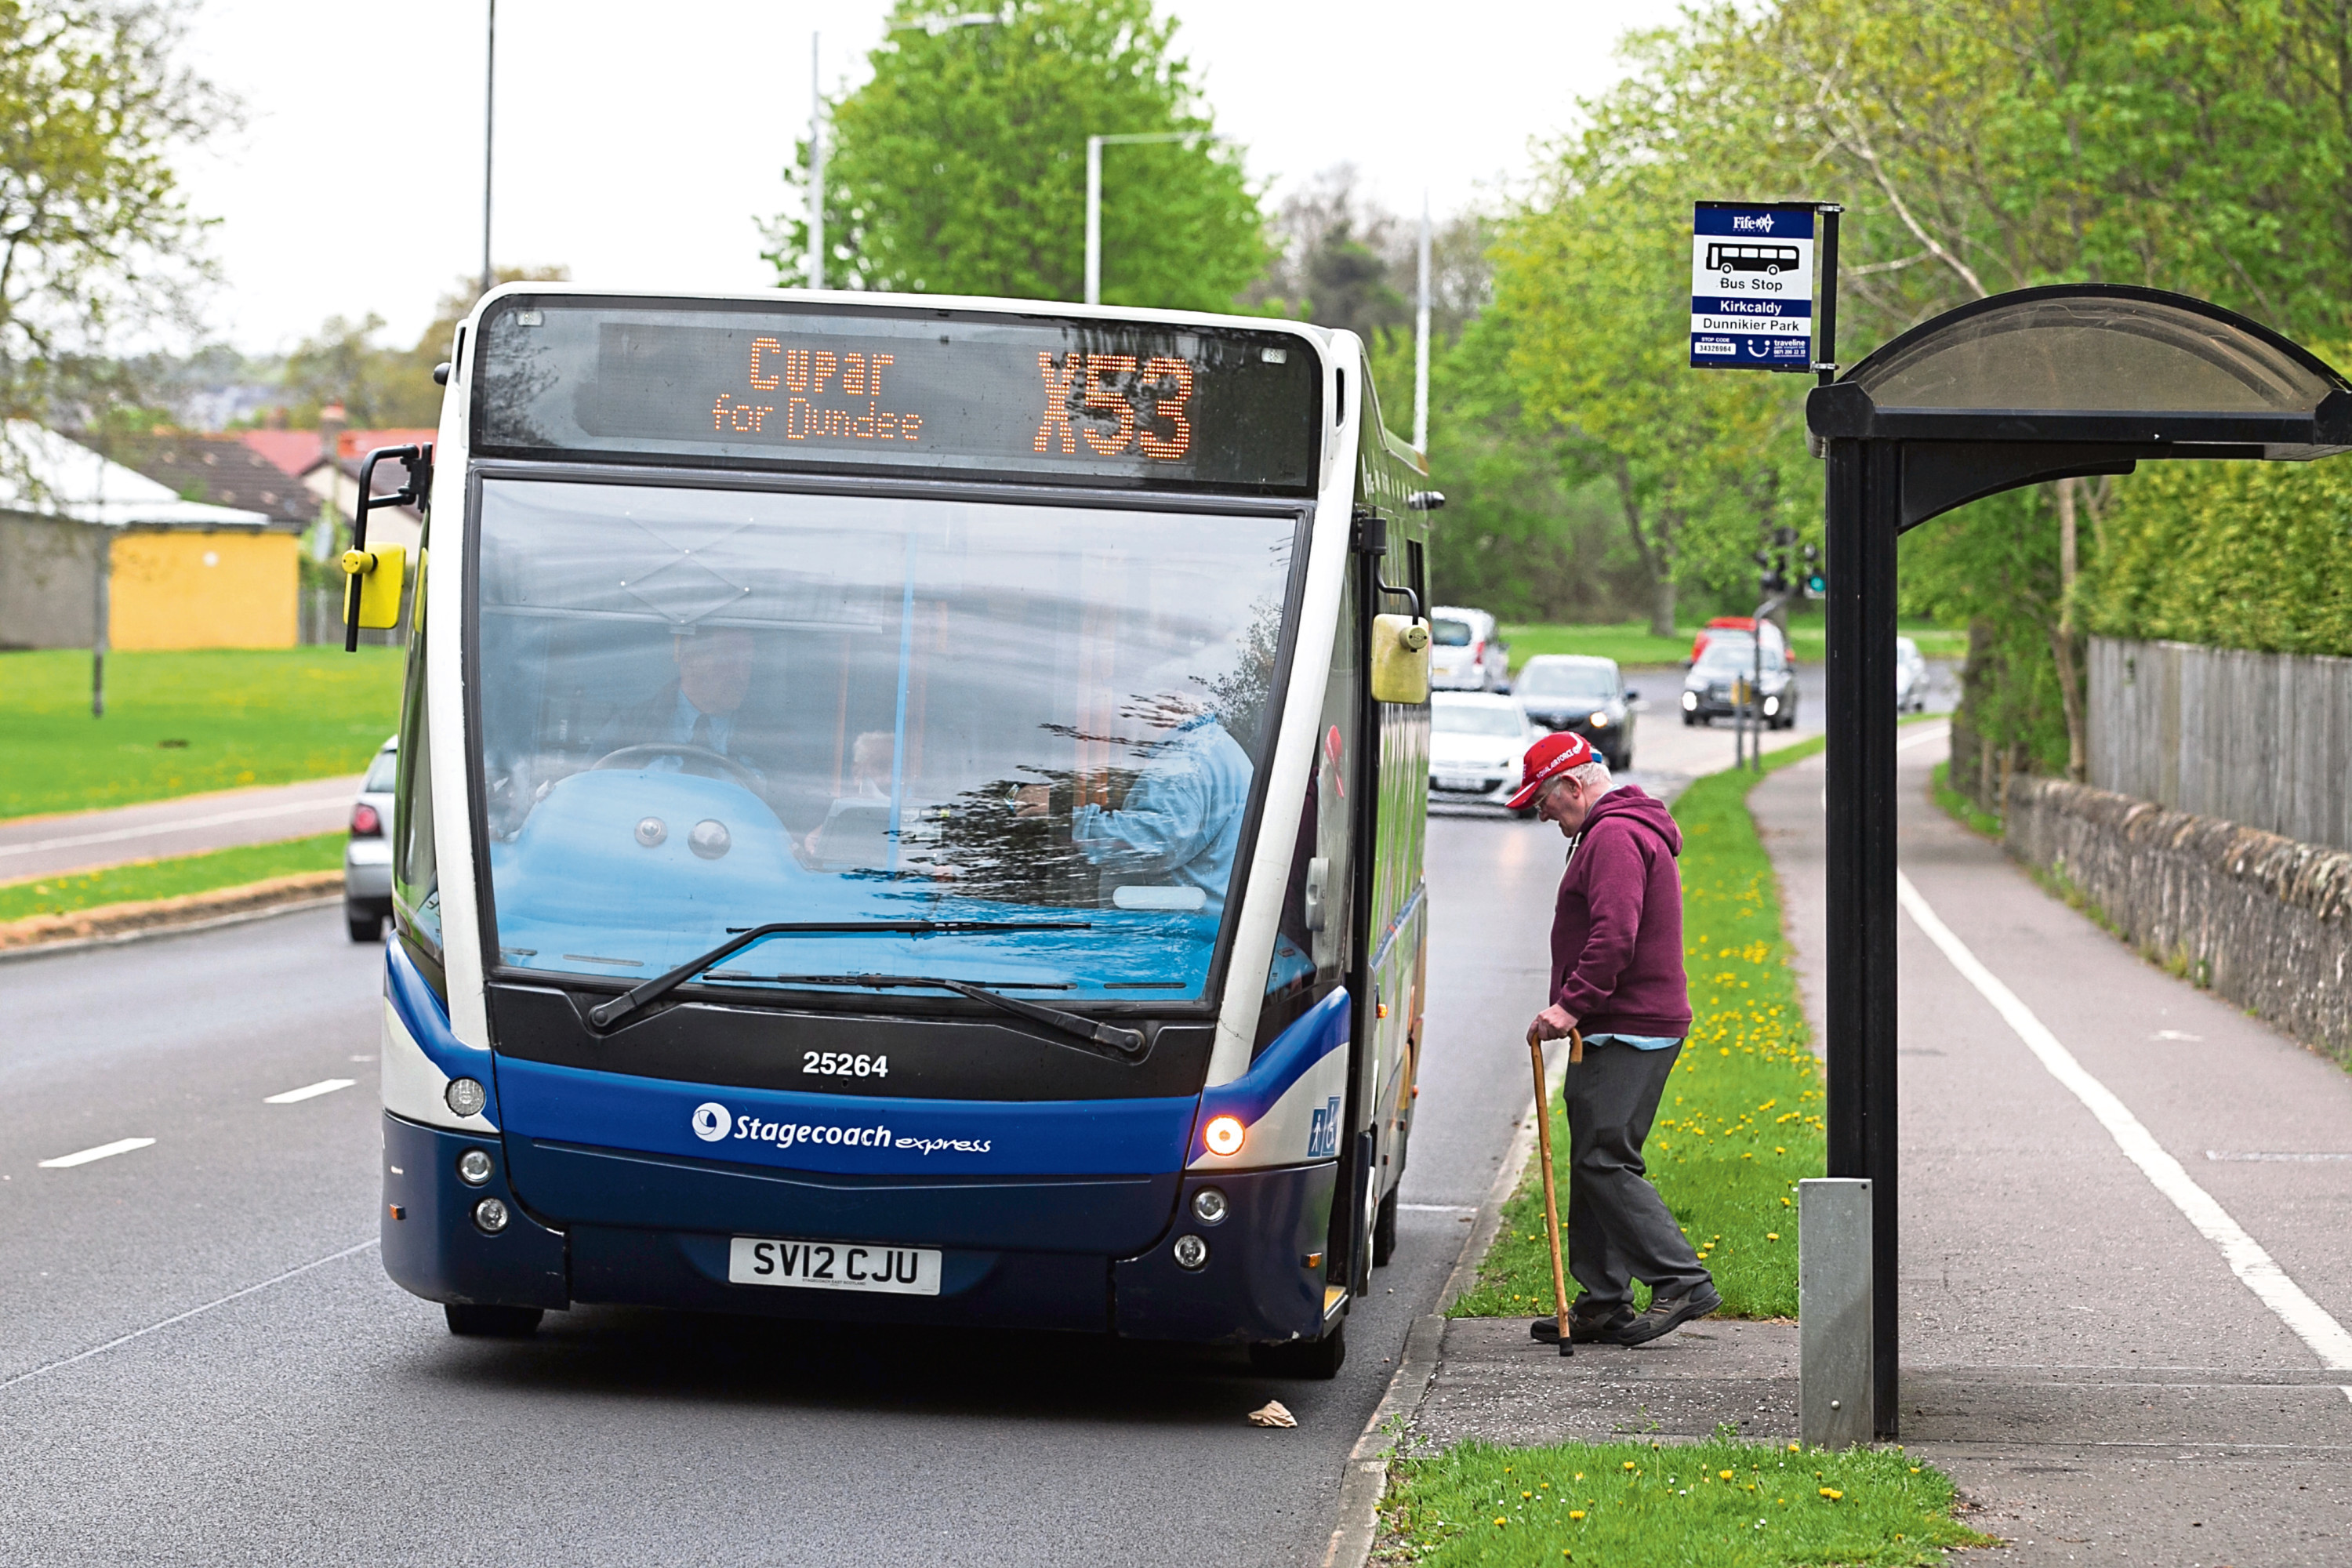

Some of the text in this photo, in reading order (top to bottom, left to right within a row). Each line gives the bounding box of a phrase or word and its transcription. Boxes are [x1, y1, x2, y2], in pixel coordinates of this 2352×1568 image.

[1733, 216, 1755, 229] Fife
[1720, 278, 1783, 292] Bus Stop
[1720, 300, 1782, 316] Kirkcaldy
[1703, 318, 1799, 331] Dunnikier Park
[750, 337, 895, 395] Cupar
[712, 393, 924, 440] for Dundee
[1033, 351, 1192, 458] X53
[1536, 766, 1552, 779] ROYAL
[1551, 759, 1559, 769] AIR
[1556, 749, 1574, 764] FORCE
[802, 1051, 888, 1077] 25264
[734, 1116, 991, 1155] Stagecoach express
[753, 1242, 919, 1284] SV12 CJU
